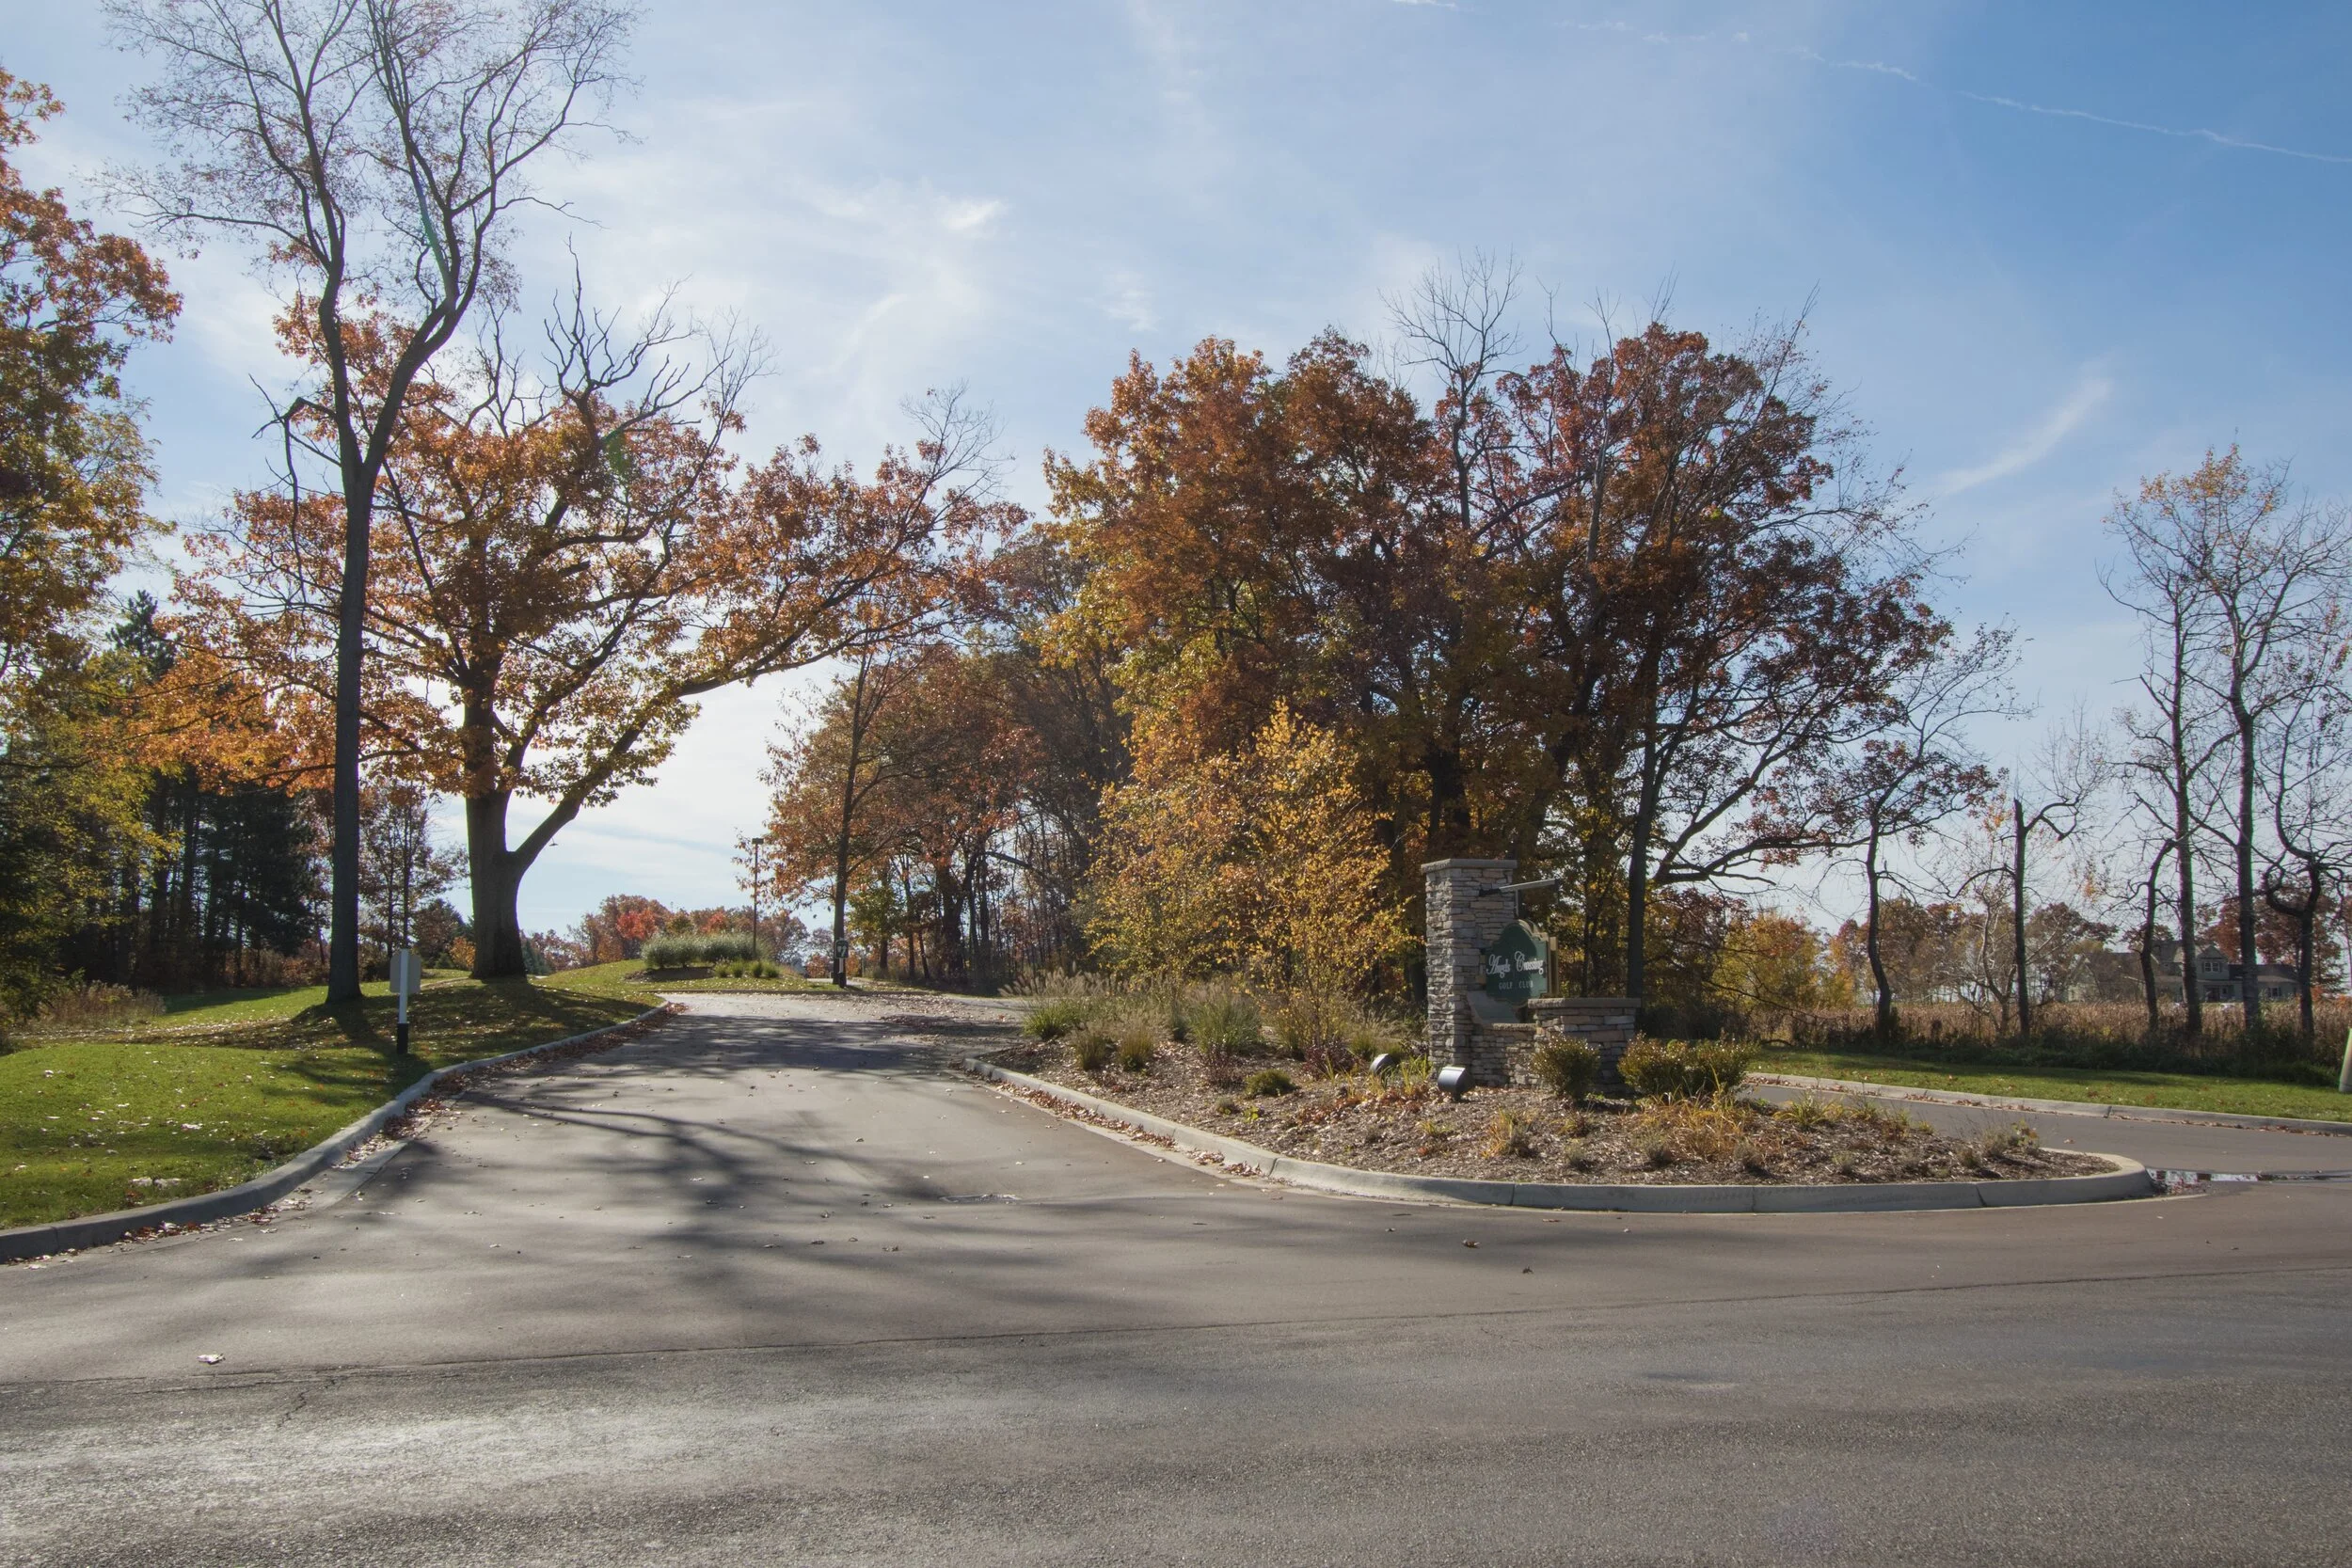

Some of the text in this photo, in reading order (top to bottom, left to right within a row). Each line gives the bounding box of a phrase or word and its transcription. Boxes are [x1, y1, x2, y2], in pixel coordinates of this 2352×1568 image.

[1486, 951, 1544, 978] Angels Crossing
[1499, 980, 1534, 990] GOLF CLUB
